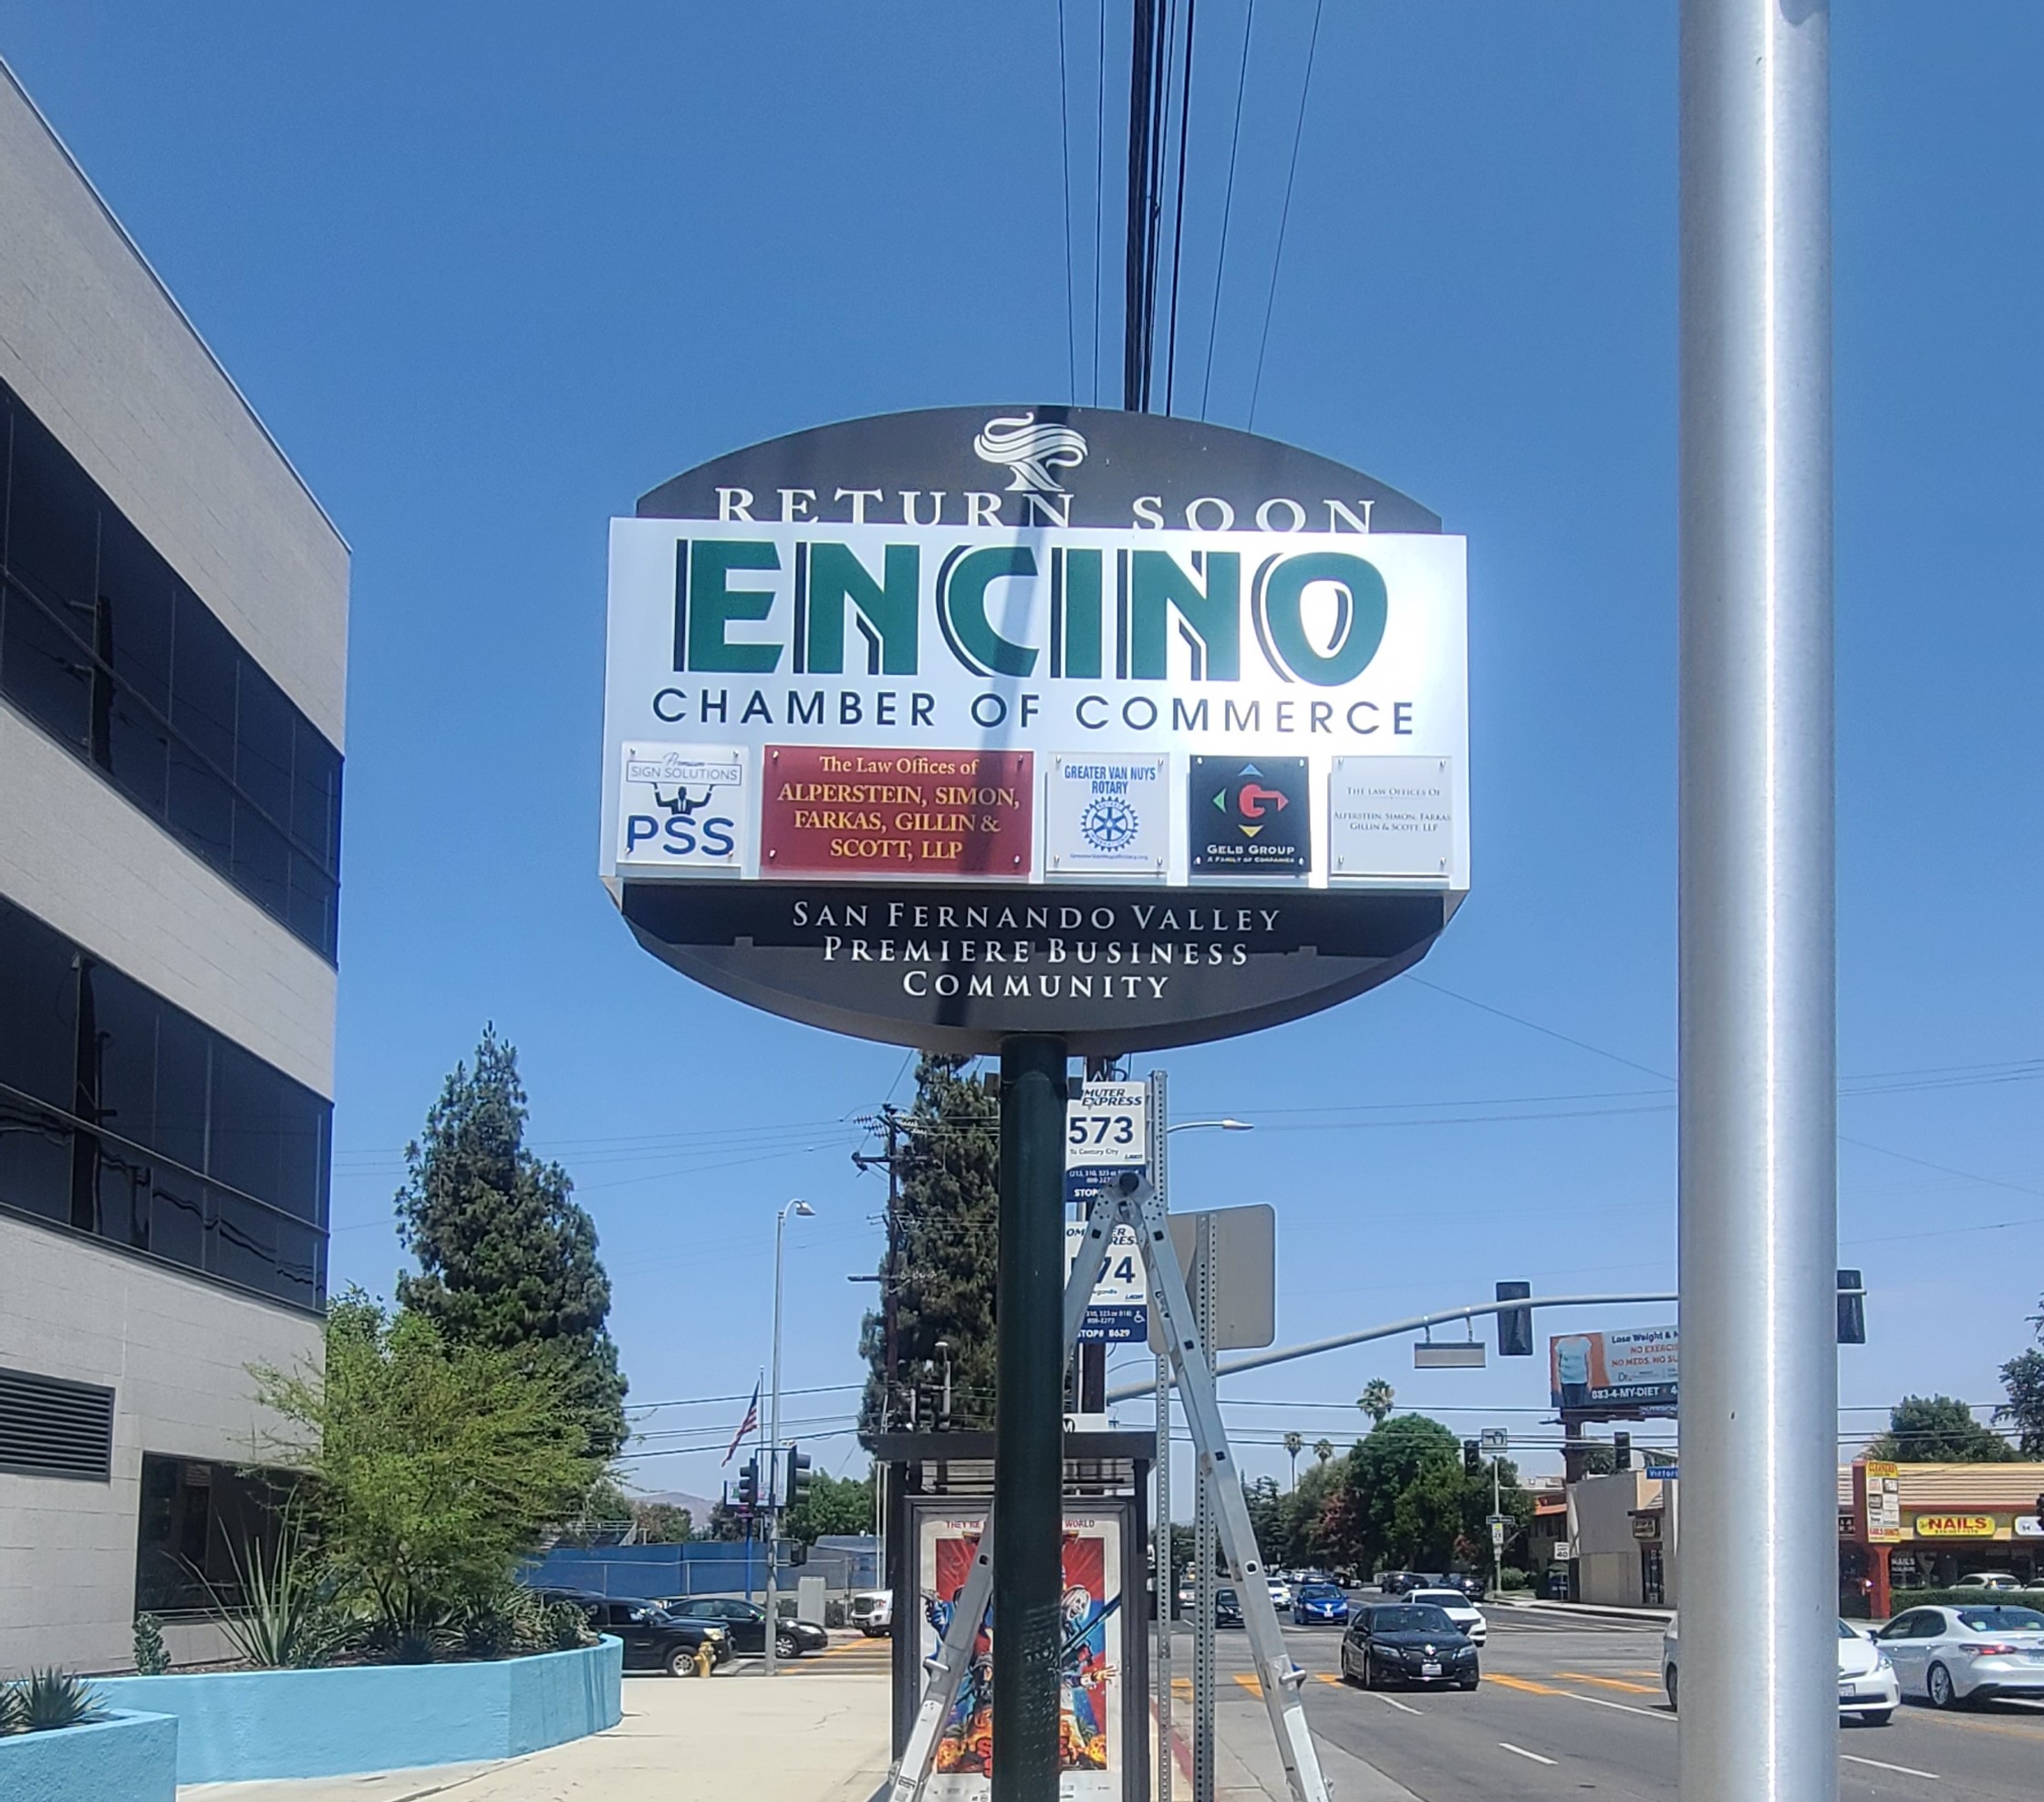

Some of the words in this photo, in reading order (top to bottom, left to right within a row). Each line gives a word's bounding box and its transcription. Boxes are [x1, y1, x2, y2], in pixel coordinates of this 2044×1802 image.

[714, 487, 1074, 527] RETURN
[1132, 495, 1375, 533] SOON
[671, 537, 1389, 688] ENCINO
[652, 687, 936, 727] CHAMBER
[970, 692, 1040, 729] OF
[1075, 694, 1414, 735] COMMERCE
[631, 766, 661, 778] SIGN
[664, 768, 738, 781] SOLUTIONS
[820, 756, 852, 773] The
[856, 757, 892, 773] Law
[896, 758, 956, 775] Offices
[960, 759, 980, 775] of
[1064, 764, 1106, 779] GREATER
[1108, 766, 1127, 780] VAN
[1130, 766, 1156, 781] NUYS
[777, 783, 928, 807] ALPERSTEIN,
[935, 786, 1021, 809] SIMON,
[1092, 781, 1129, 794] ROTARY
[794, 810, 887, 834] FARKAS,
[895, 813, 976, 832] GILLIN
[980, 815, 1001, 833] &
[627, 814, 735, 856] PSS
[830, 838, 913, 862] SCOTT,
[921, 840, 963, 859] LLP
[1207, 844, 1244, 854] GELB
[1248, 844, 1295, 855] GROUP
[793, 900, 868, 927] SAN
[887, 901, 1115, 930] FERNANDO
[1132, 904, 1280, 932] VALLEY
[823, 936, 1029, 964] PREMIERE
[1047, 937, 1248, 966] BUSINESS
[903, 969, 1170, 999] COMMUNITY
[1082, 1096, 1142, 1106] EXPRESS
[1084, 1088, 1126, 1096] MUTER
[1069, 1116, 1134, 1144] 573
[1074, 1188, 1100, 1197] STOP
[1612, 1335, 1631, 1343] Lose
[1633, 1331, 1663, 1342] Weight
[1612, 1359, 1624, 1368] NO
[1064, 1519, 1095, 1528] WORLD
[1927, 1517, 1987, 1529] NAILS
